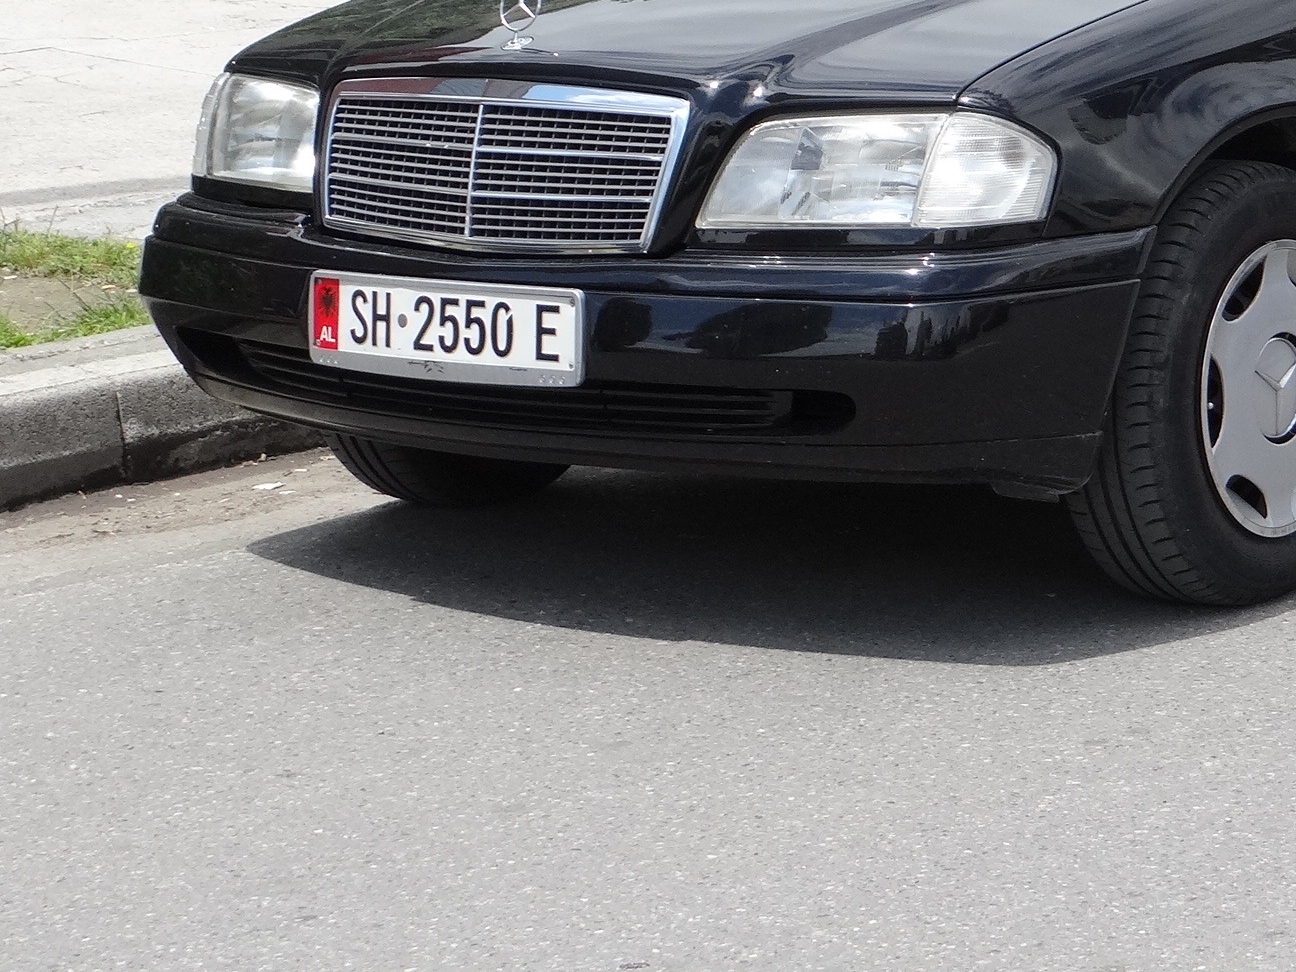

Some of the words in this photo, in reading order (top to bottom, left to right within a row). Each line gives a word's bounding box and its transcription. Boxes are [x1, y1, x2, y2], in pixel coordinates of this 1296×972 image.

[319, 325, 336, 343] AL
[350, 289, 392, 348] SH
[413, 295, 514, 358] 2550
[535, 303, 561, 362] E
